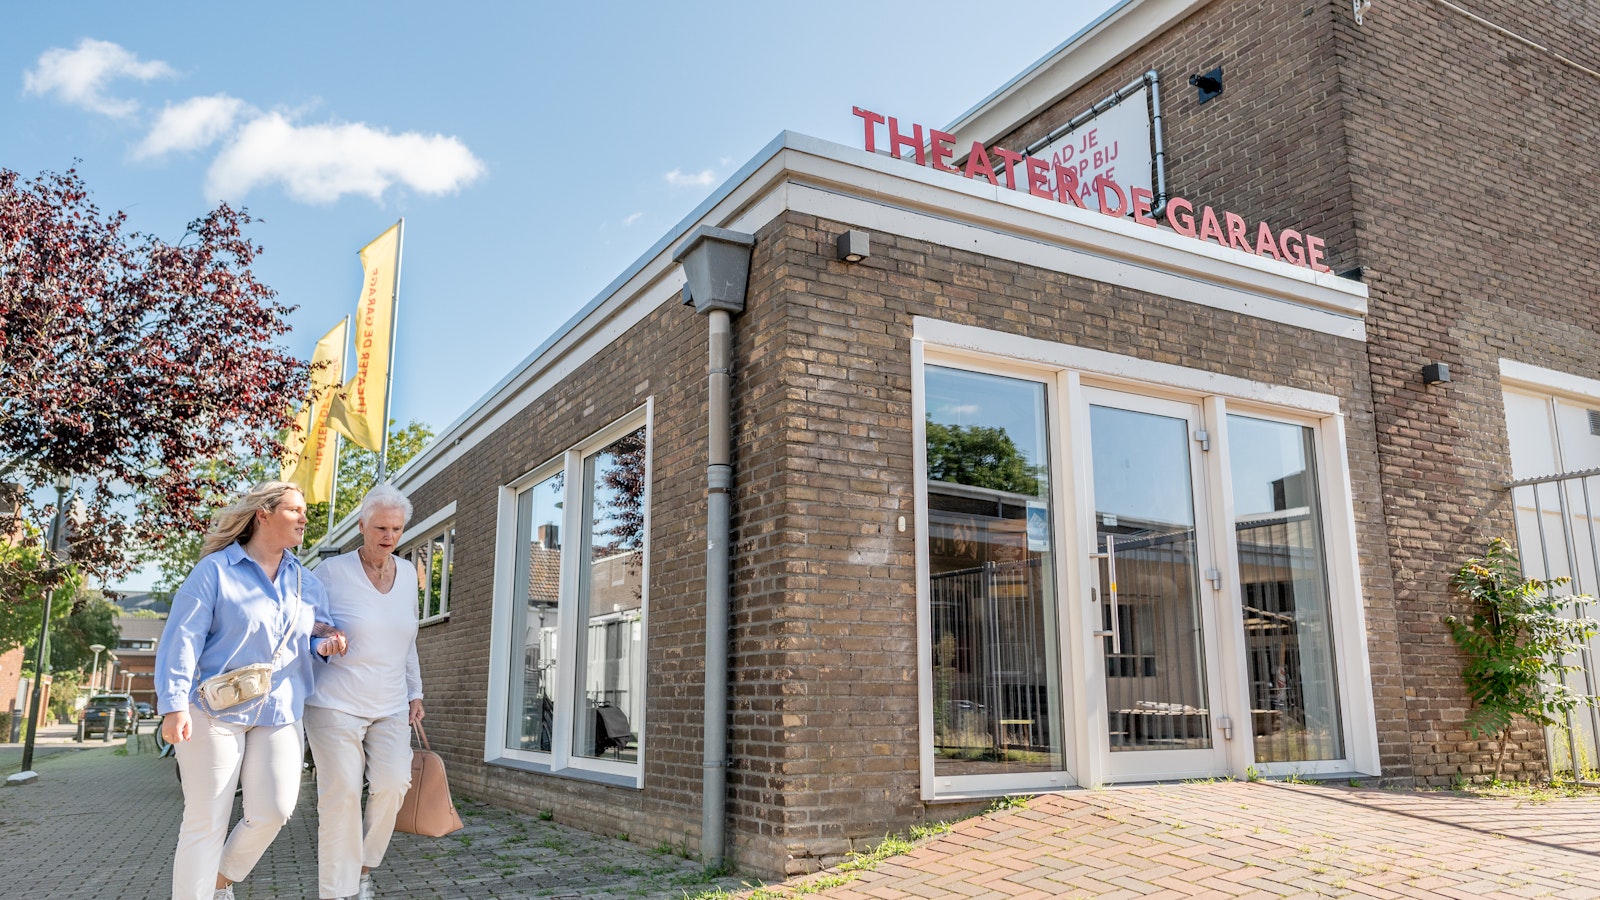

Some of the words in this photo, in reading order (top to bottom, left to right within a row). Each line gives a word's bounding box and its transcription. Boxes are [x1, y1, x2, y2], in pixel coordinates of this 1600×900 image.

[1079, 128, 1099, 154] JE
[1093, 141, 1118, 170] BIJ
[853, 106, 1088, 209] THEATER
[1098, 177, 1157, 228] DE
[1166, 197, 1331, 273] GARAGE
